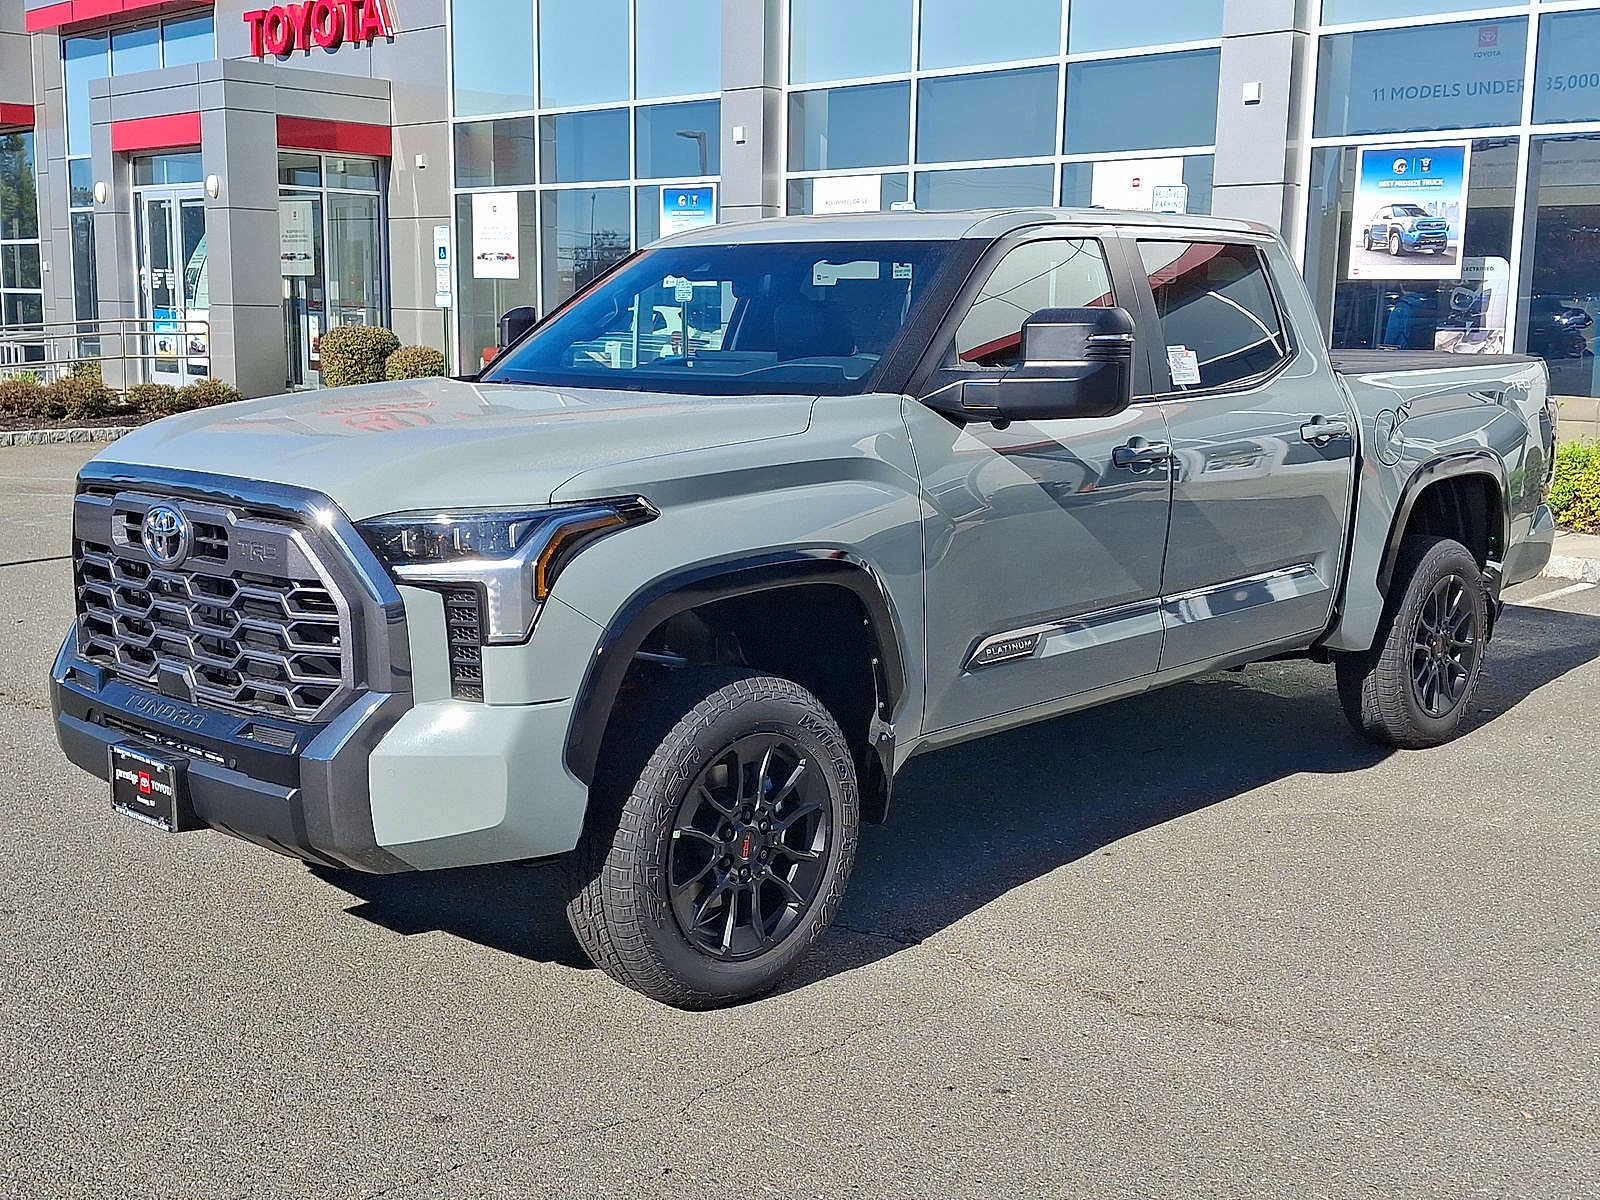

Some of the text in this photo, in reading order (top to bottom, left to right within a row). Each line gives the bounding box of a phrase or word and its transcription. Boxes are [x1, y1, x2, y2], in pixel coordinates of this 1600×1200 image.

[243, 0, 394, 57] TOYOTA
[1473, 50, 1501, 58] TOYOTA
[1372, 88, 1385, 101] 11
[1390, 83, 1461, 100] MODELS
[1546, 73, 1600, 91] 35,000
[986, 640, 1032, 656] PLATINUM
[126, 695, 208, 728] TUNDRA
